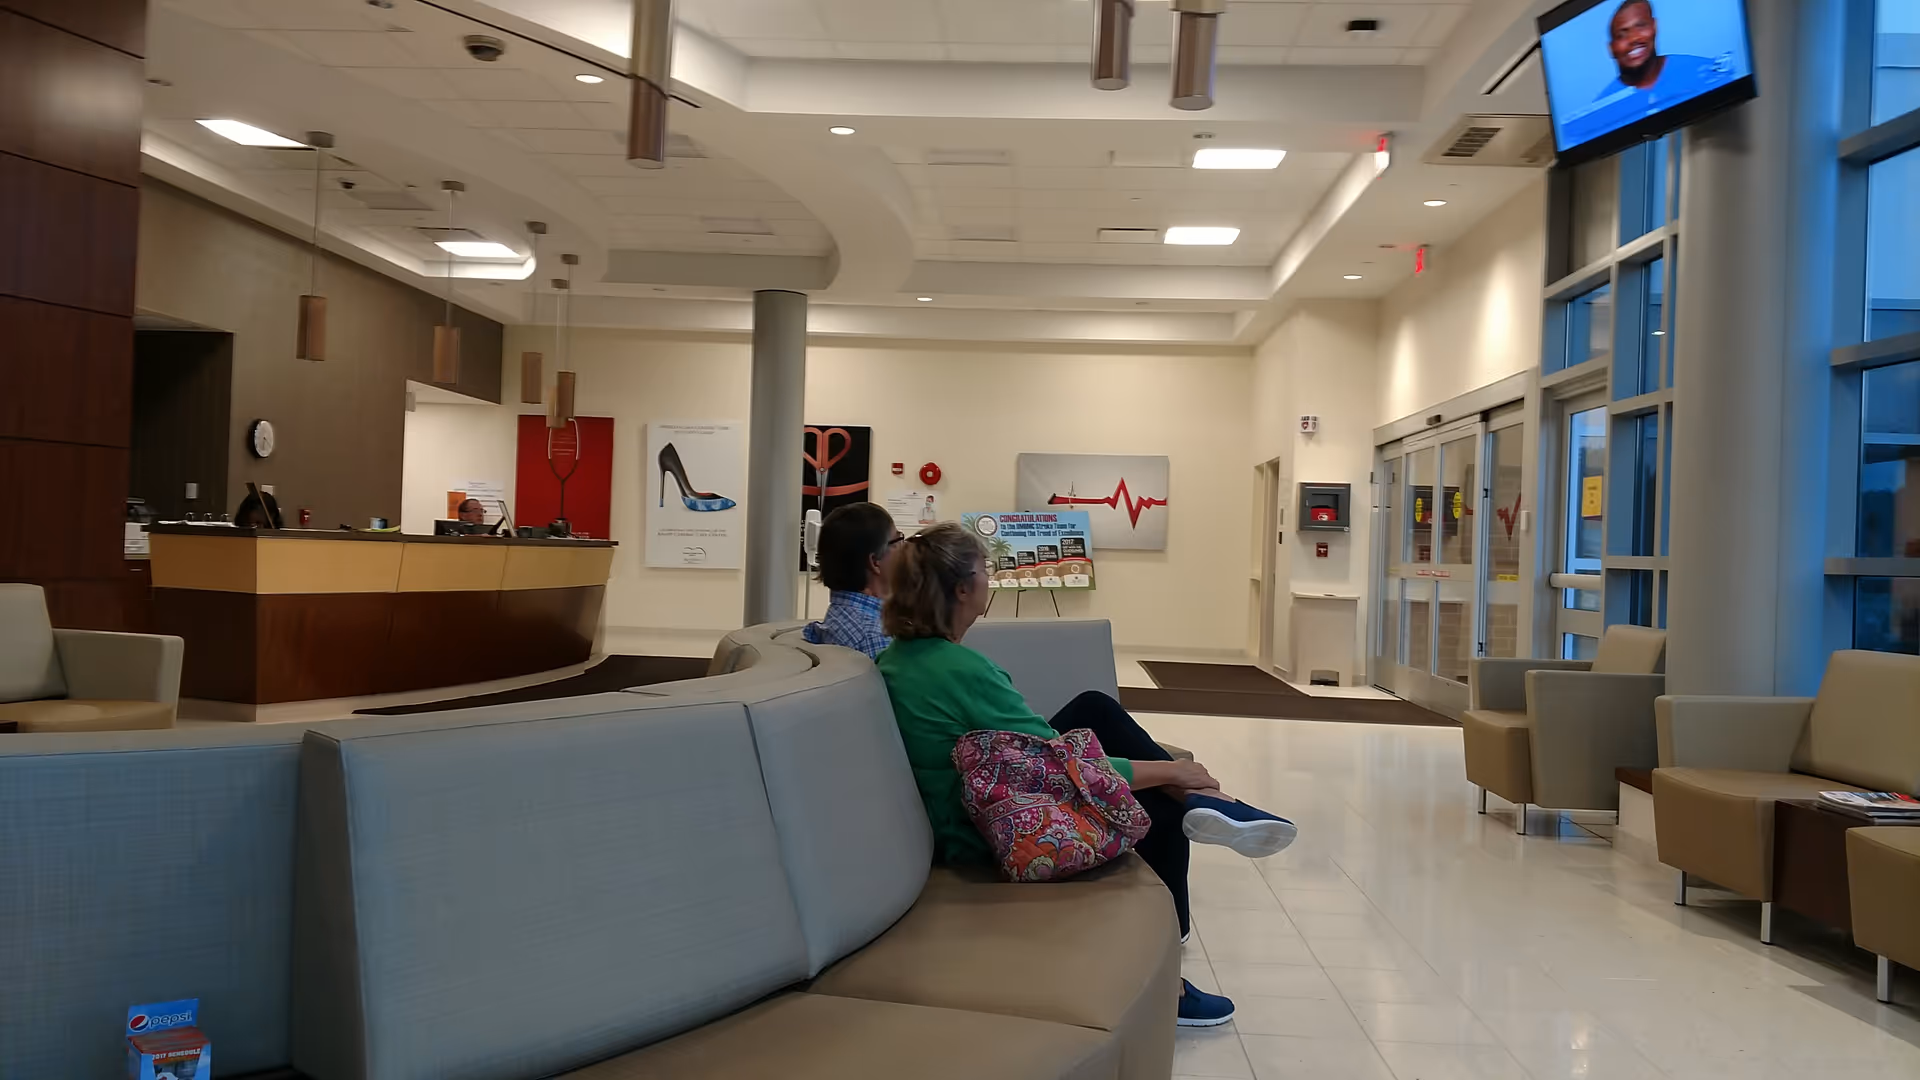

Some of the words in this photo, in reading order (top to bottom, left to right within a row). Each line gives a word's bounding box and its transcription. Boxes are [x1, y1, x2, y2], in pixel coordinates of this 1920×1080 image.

[1000, 514, 1057, 522] CONGRATULATIONS
[149, 1010, 192, 1028] pepsi
[168, 1049, 201, 1057] SCHEDULE
